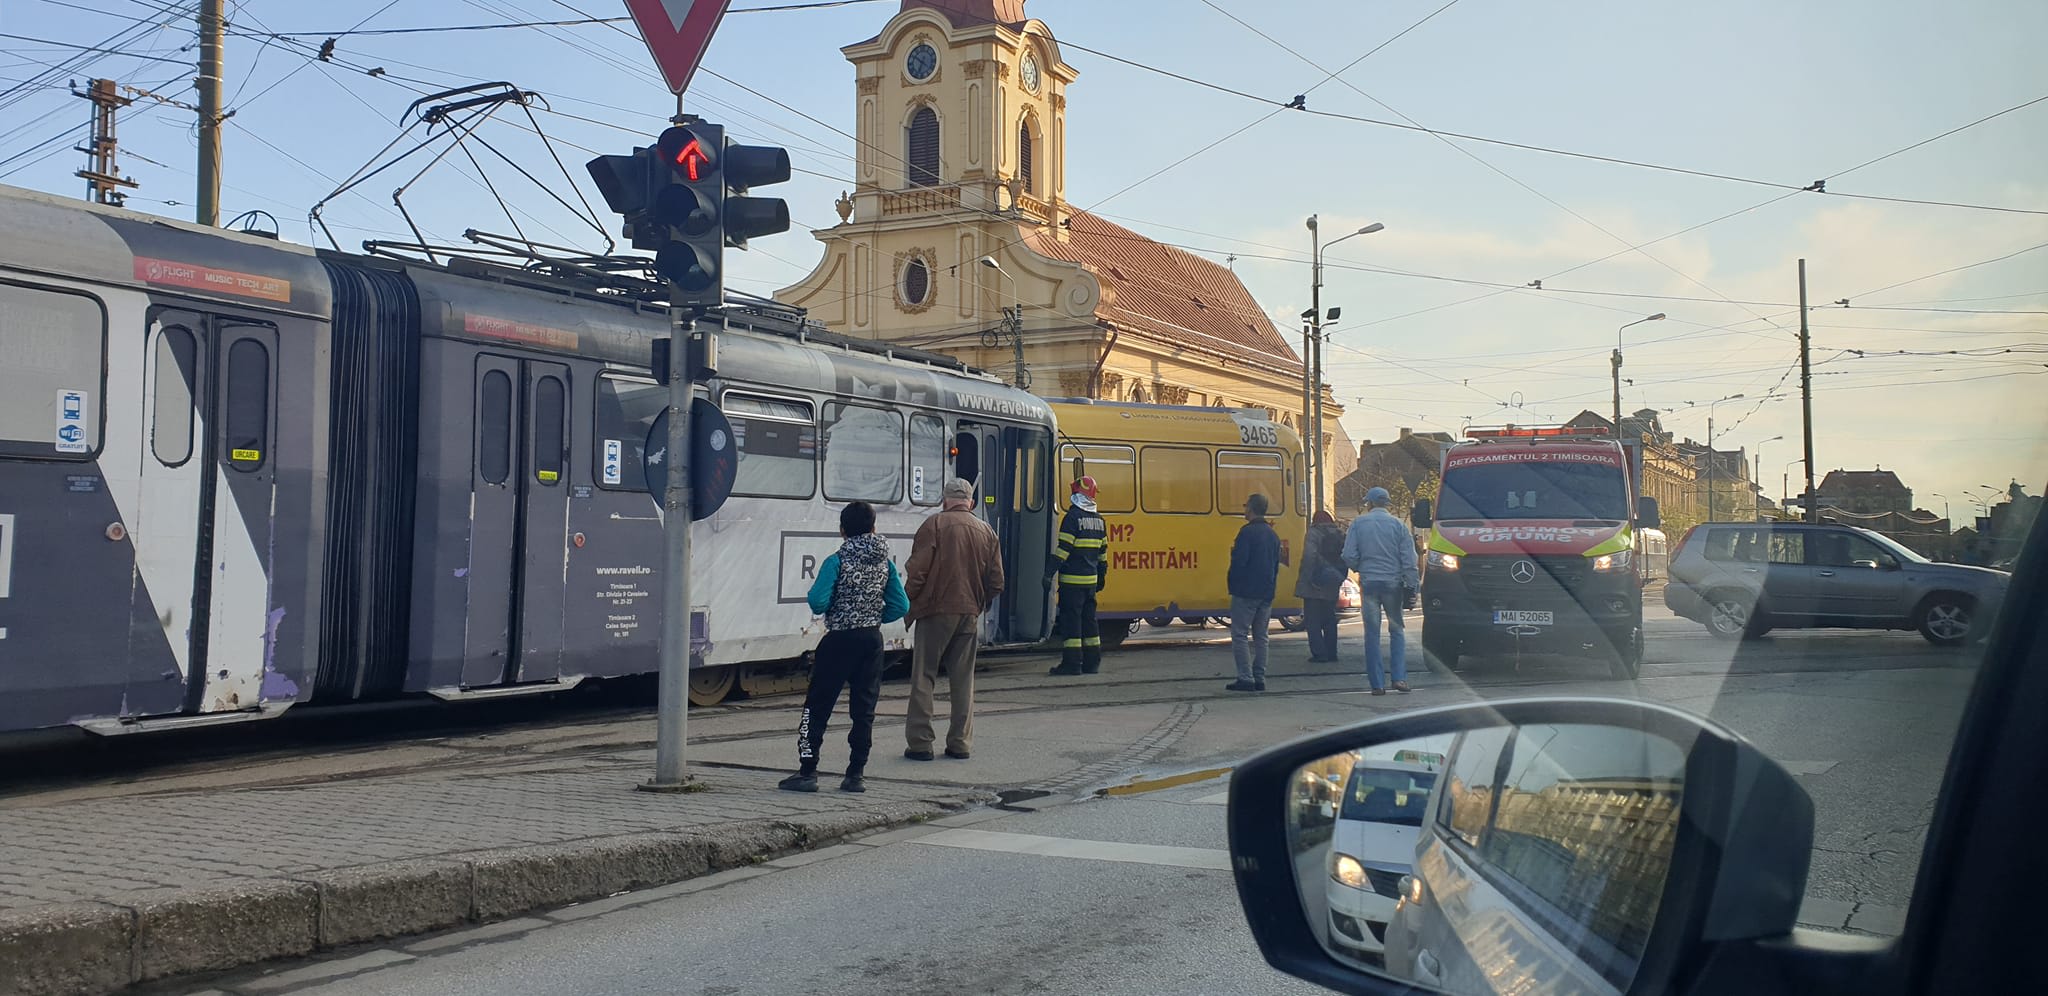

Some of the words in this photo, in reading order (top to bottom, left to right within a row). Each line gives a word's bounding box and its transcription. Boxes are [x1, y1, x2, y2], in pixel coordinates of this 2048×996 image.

[163, 265, 196, 279] FLIGHT
[205, 273, 234, 285] MUSIC
[237, 278, 260, 289] TECH
[956, 392, 1045, 419] www.raveli.ro
[1240, 425, 1278, 445] 3465
[1449, 453, 1537, 467] DETASAMENTUL
[1552, 453, 1616, 465] TIMISOARA
[1112, 547, 1198, 569] MERITĂM!
[596, 565, 651, 575] www.raveli.ro
[1501, 611, 1517, 622] MAI
[1519, 611, 1551, 622] 52065
